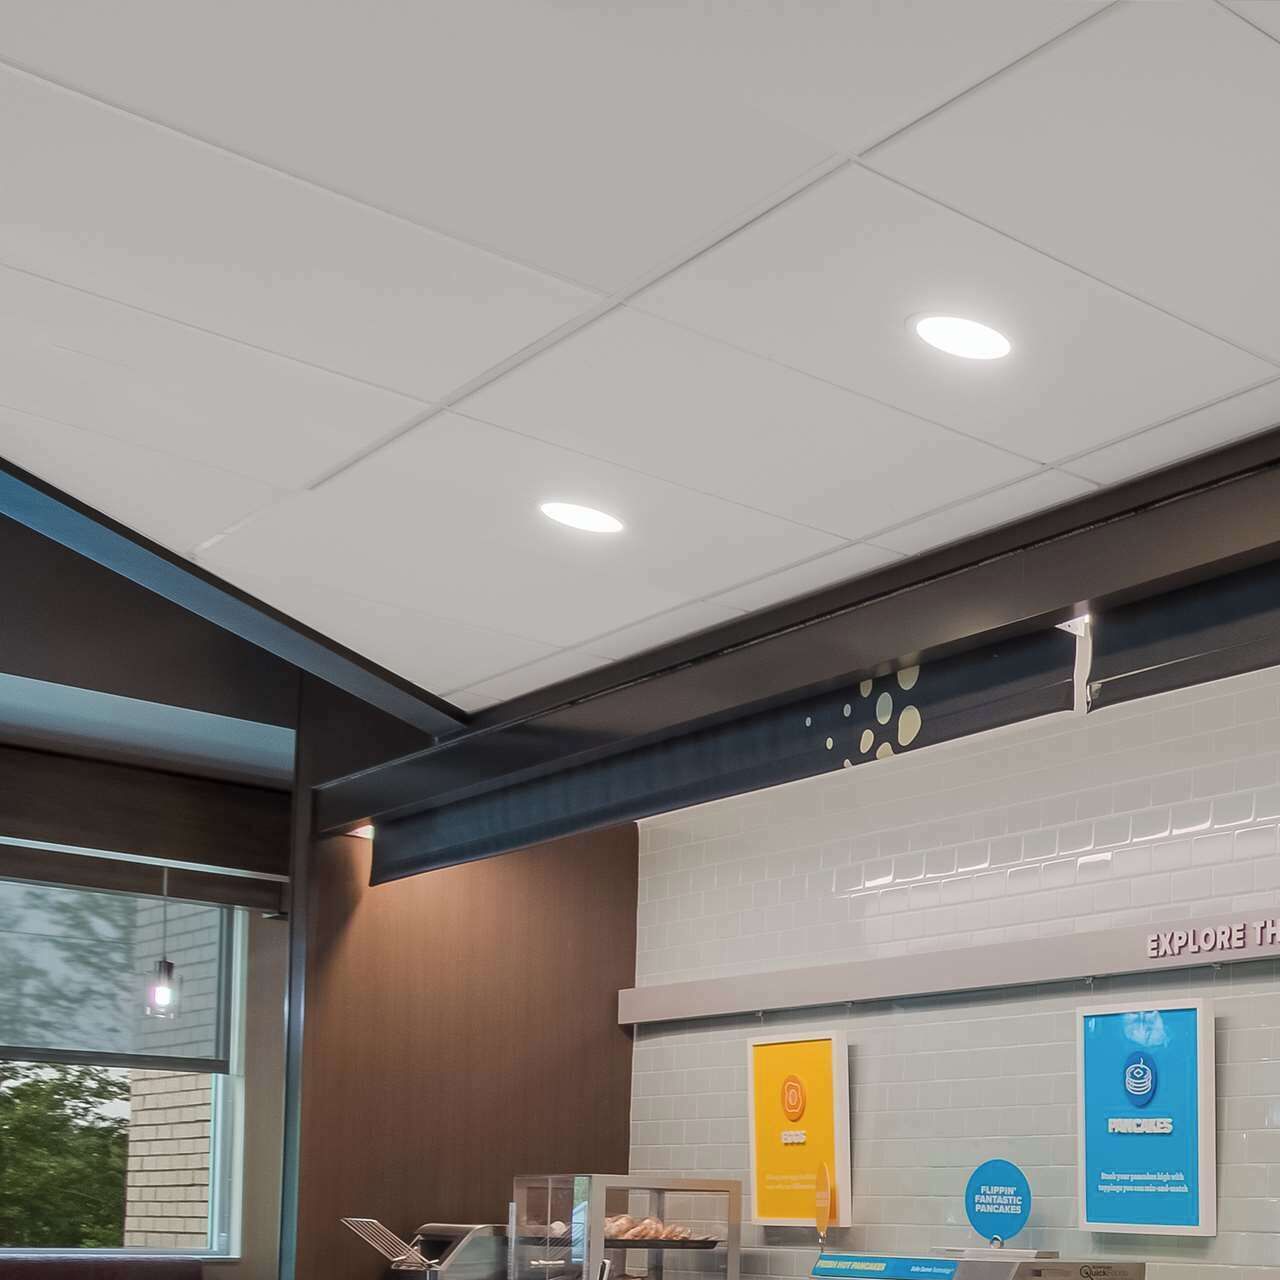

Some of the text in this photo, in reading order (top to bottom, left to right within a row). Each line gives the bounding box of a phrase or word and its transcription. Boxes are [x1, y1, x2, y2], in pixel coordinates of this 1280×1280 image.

[1148, 919, 1246, 958] EXPLORE
[980, 1185, 1017, 1195] FLIPPIN'
[975, 1195, 1022, 1204] FANTASTIC
[975, 1204, 1021, 1214] PANCAKES
